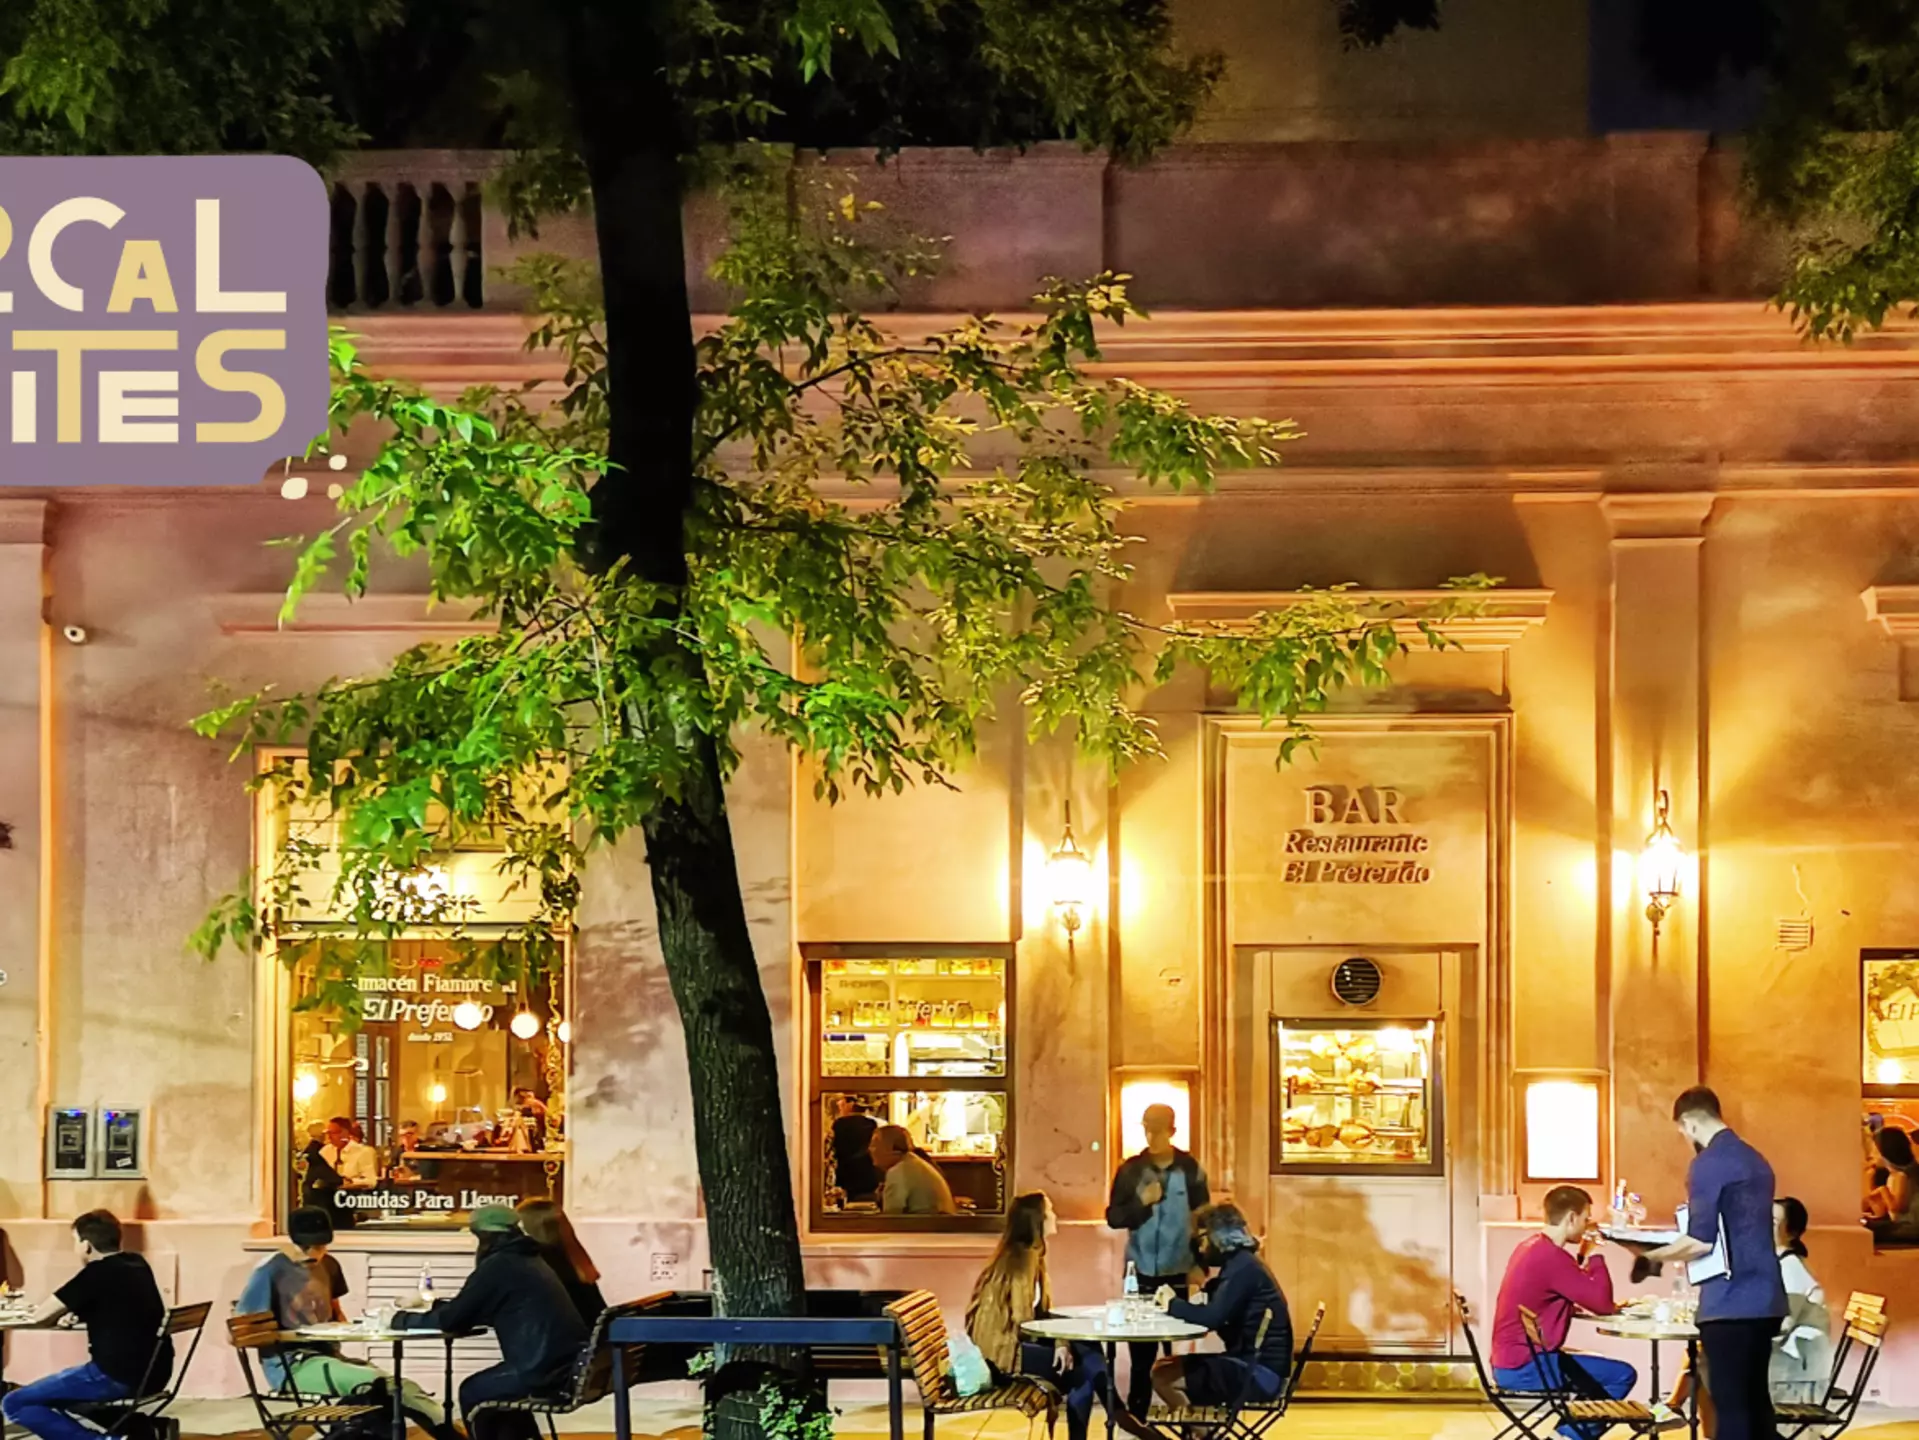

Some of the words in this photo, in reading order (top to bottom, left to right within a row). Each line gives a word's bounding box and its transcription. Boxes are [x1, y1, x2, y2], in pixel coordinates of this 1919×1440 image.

[1304, 786, 1410, 826] BAR
[1282, 831, 1430, 854] Restaurante
[1280, 860, 1308, 884] El
[1316, 860, 1435, 884] Preferido
[334, 1190, 410, 1209] Comidas
[414, 1190, 455, 1209] Para
